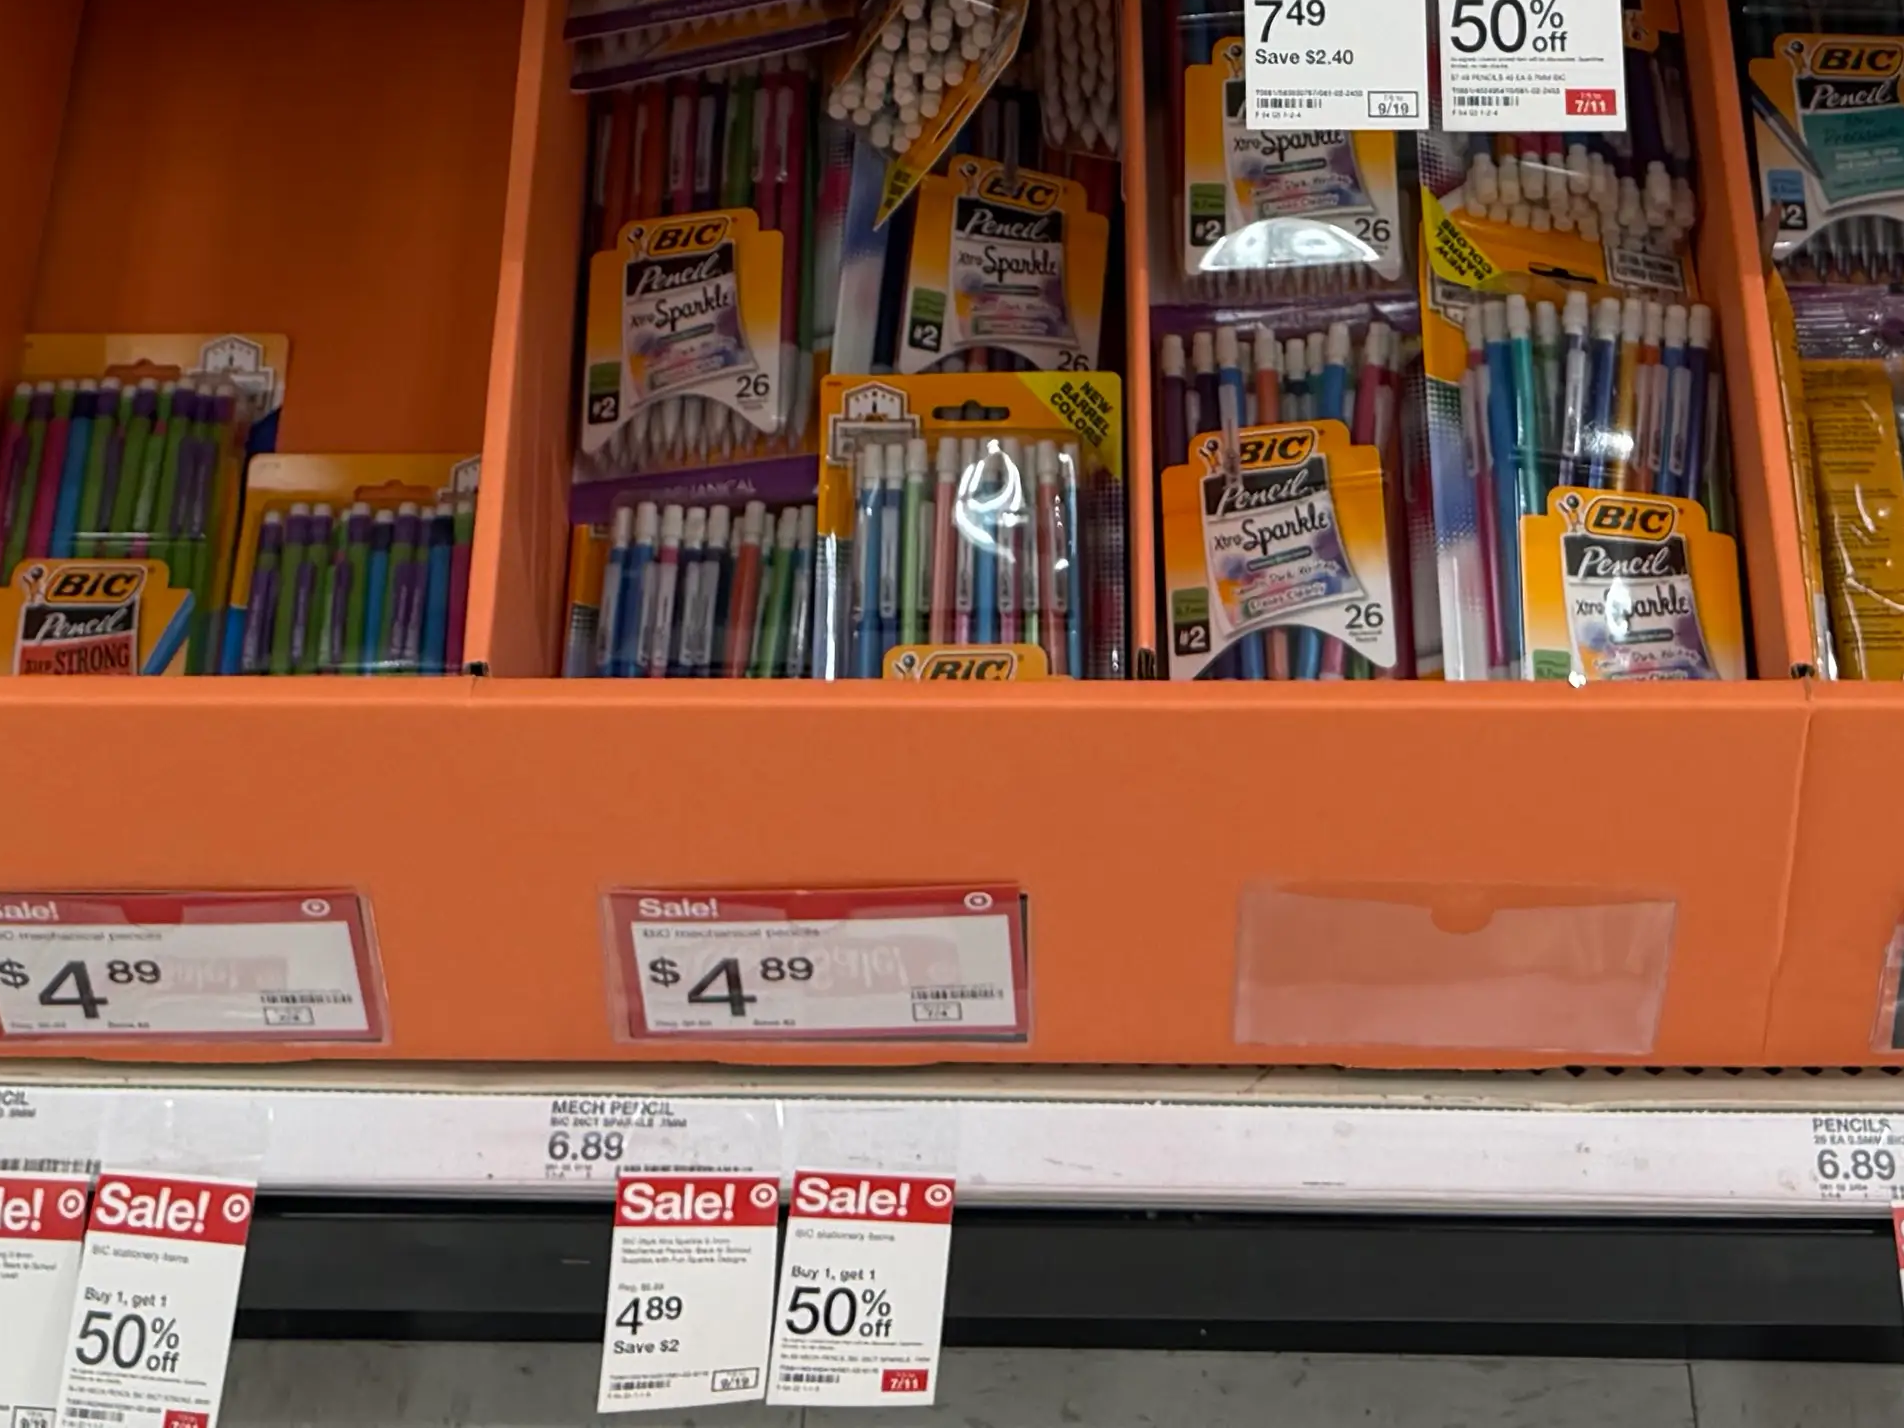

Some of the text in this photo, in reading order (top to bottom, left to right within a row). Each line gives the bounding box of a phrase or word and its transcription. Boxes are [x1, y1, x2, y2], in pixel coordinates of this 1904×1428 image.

[1255, 48, 1354, 66] Save $2.40
[1241, 510, 1328, 554] Sparkle
[620, 1182, 735, 1223] Sale!
